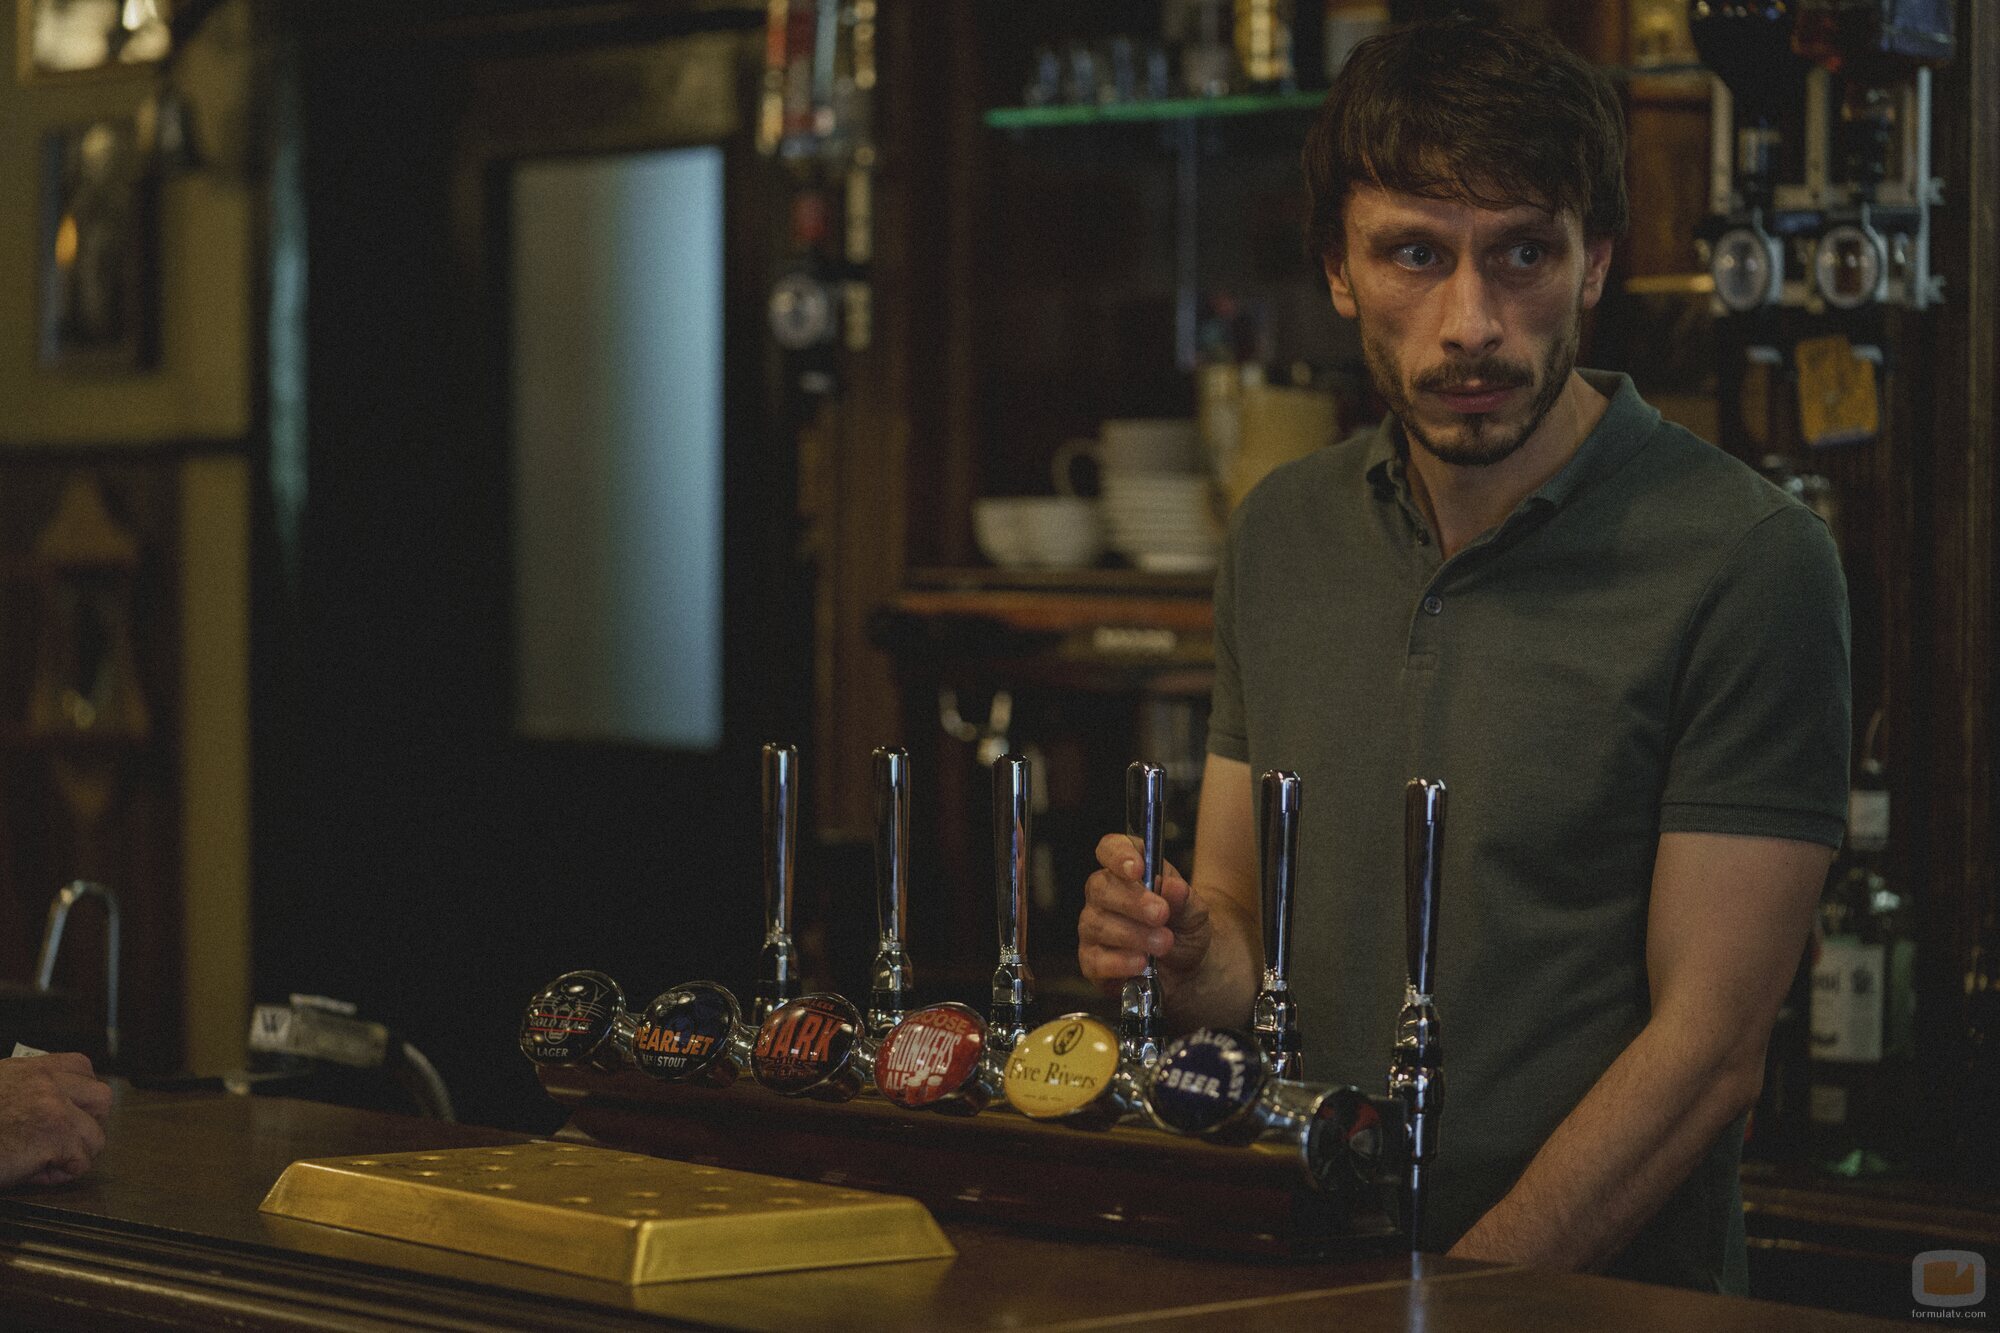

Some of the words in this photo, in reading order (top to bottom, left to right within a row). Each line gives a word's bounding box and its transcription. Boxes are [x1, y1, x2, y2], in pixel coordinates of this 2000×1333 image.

[681, 1034, 715, 1055] JET
[755, 1010, 842, 1064] DARK
[537, 1047, 568, 1057] LAGER
[657, 1056, 687, 1069] STOUT
[1008, 1057, 1041, 1081] Five
[1044, 1062, 1098, 1088] Rivers
[1167, 1068, 1220, 1098] BEER
